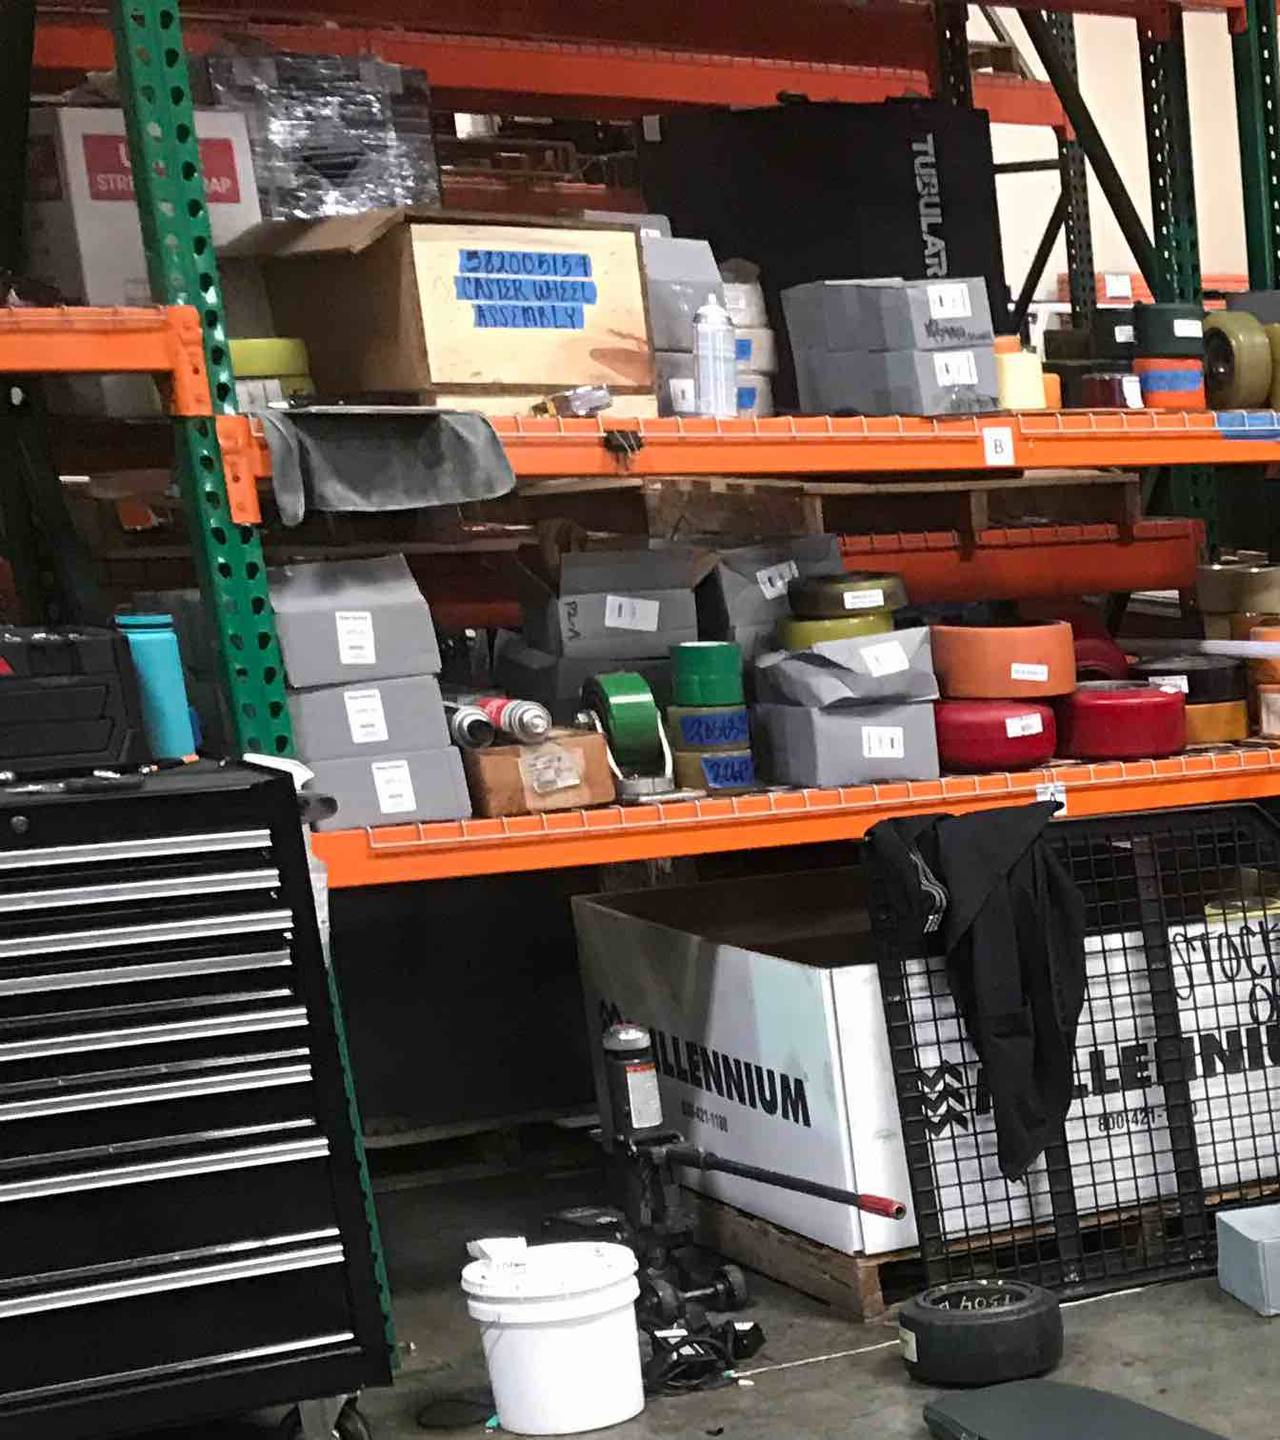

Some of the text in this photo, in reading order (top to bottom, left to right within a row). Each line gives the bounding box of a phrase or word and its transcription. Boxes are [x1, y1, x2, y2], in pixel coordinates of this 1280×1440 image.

[911, 132, 948, 278] TUBULAR
[462, 277, 593, 301] CASTER WHEEL
[475, 304, 577, 328] ASSEMBLY
[994, 438, 1004, 454] B
